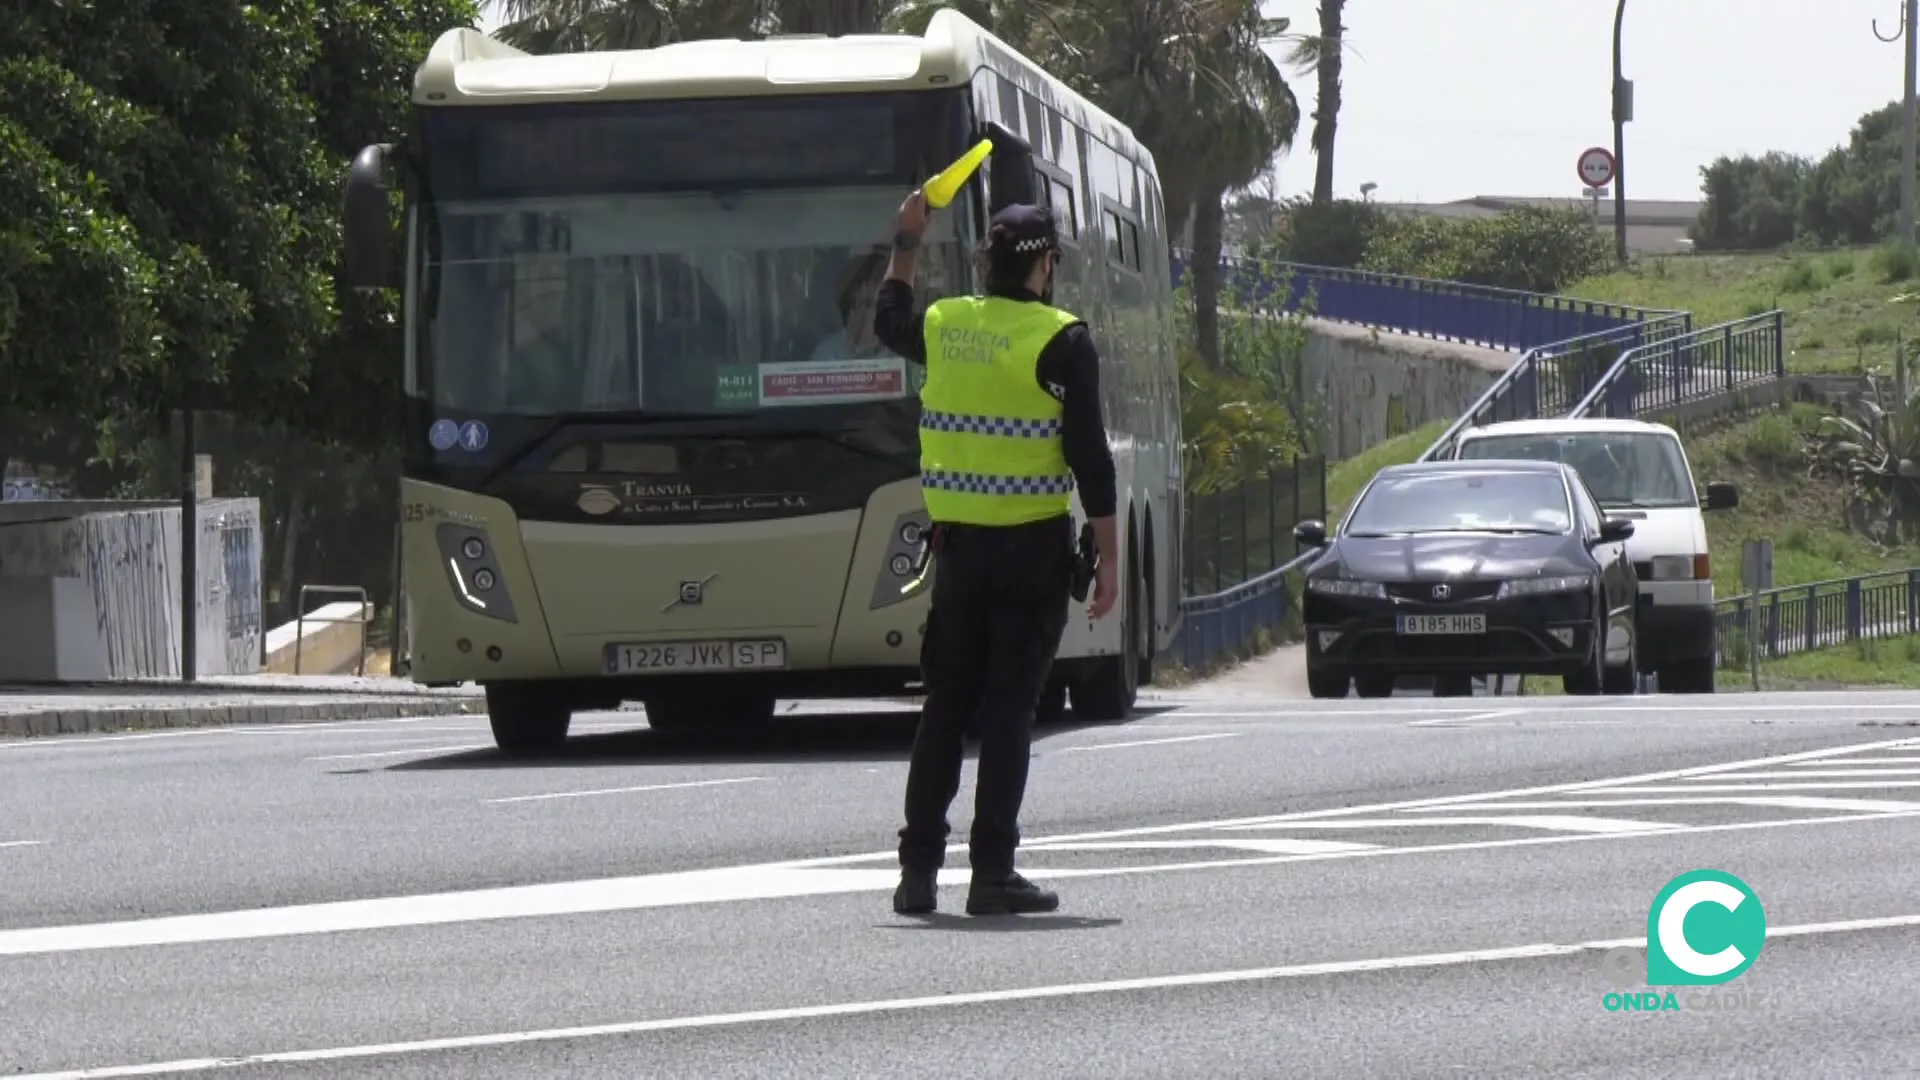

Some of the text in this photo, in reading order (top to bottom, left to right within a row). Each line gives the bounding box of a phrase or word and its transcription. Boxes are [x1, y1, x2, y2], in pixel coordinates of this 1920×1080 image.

[1408, 615, 1482, 632] 8185 HHS
[625, 647, 676, 669] 1226
[685, 644, 724, 666] JVK
